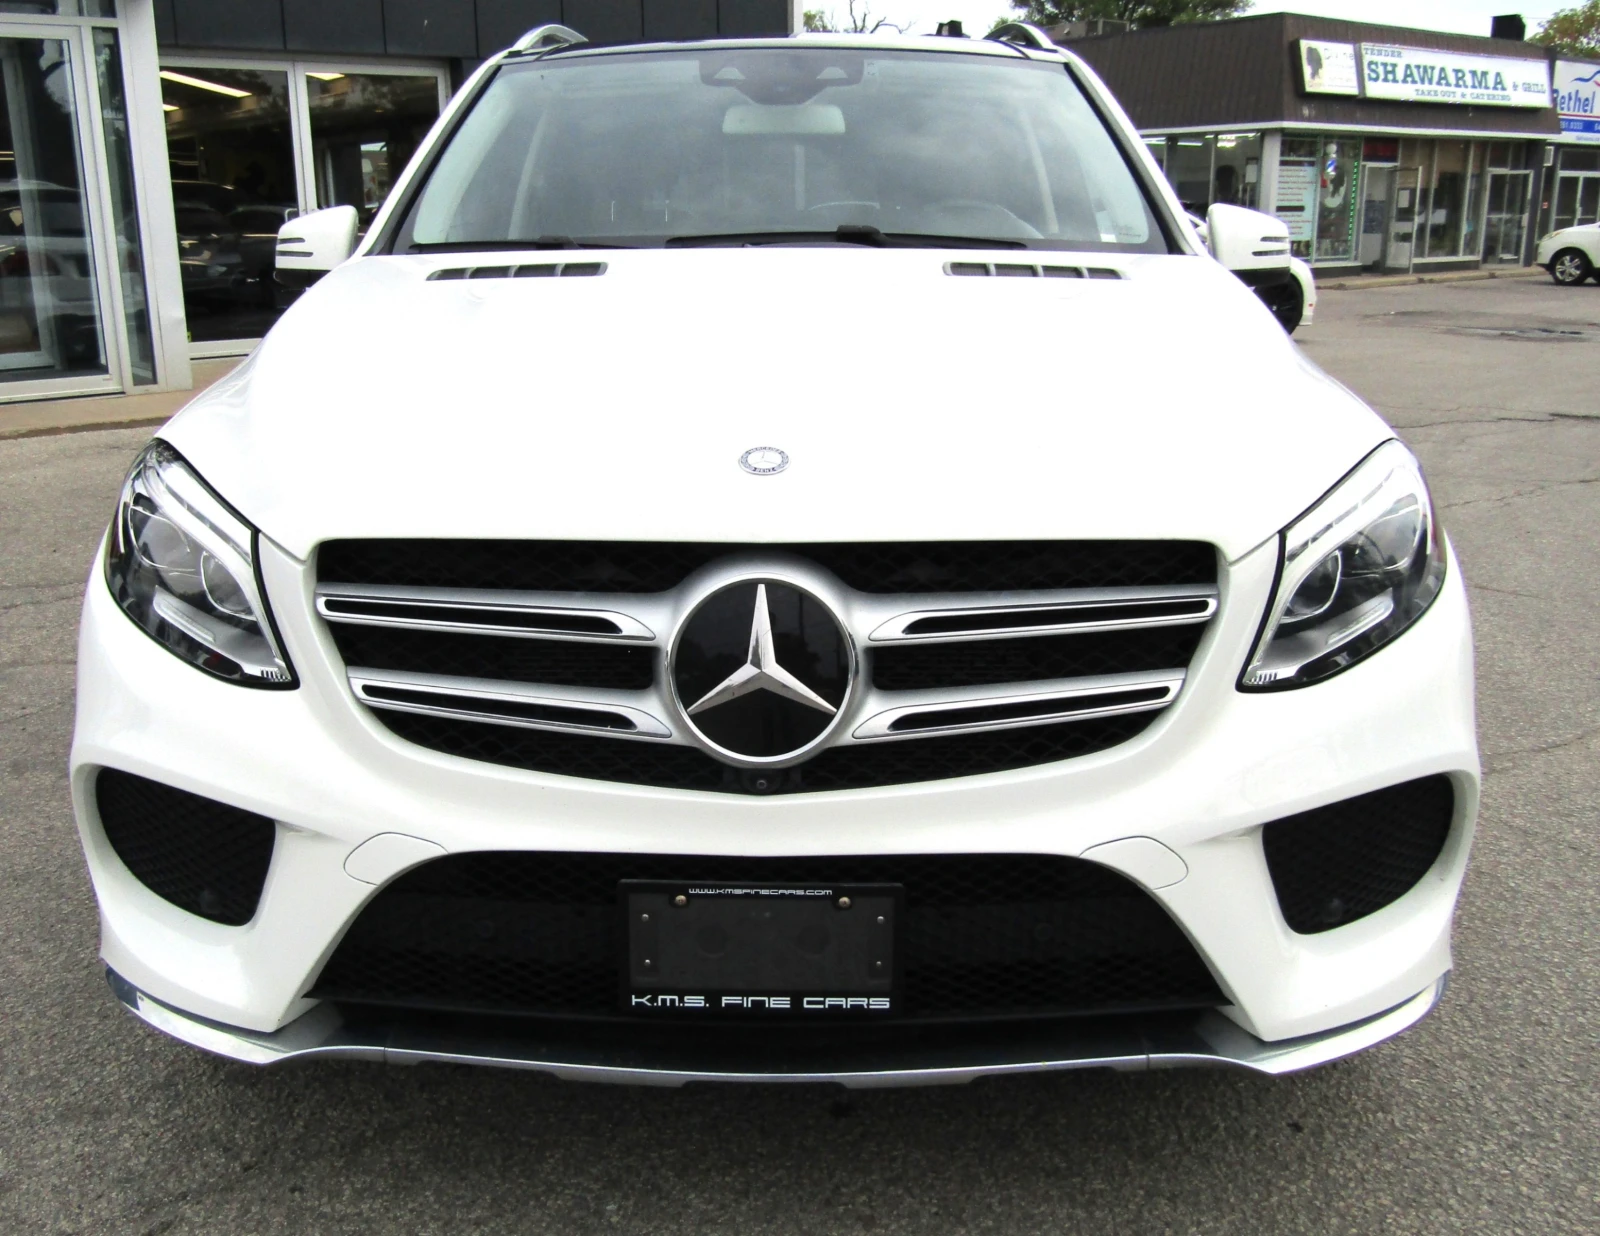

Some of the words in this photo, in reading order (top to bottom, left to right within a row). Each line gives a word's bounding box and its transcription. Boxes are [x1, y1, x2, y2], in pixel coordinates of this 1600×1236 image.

[1363, 47, 1403, 58] TENDER
[1367, 60, 1507, 91] SHAWARMA
[1512, 81, 1519, 91] &
[1522, 82, 1546, 94] GRILL
[1415, 88, 1438, 97] TAKE
[1470, 92, 1511, 102] CATERING
[688, 887, 833, 896] WWW.KMSFINECARS.COM
[631, 994, 710, 1008] K.M.S.
[721, 996, 791, 1009] FINE
[803, 997, 890, 1010] CARS
